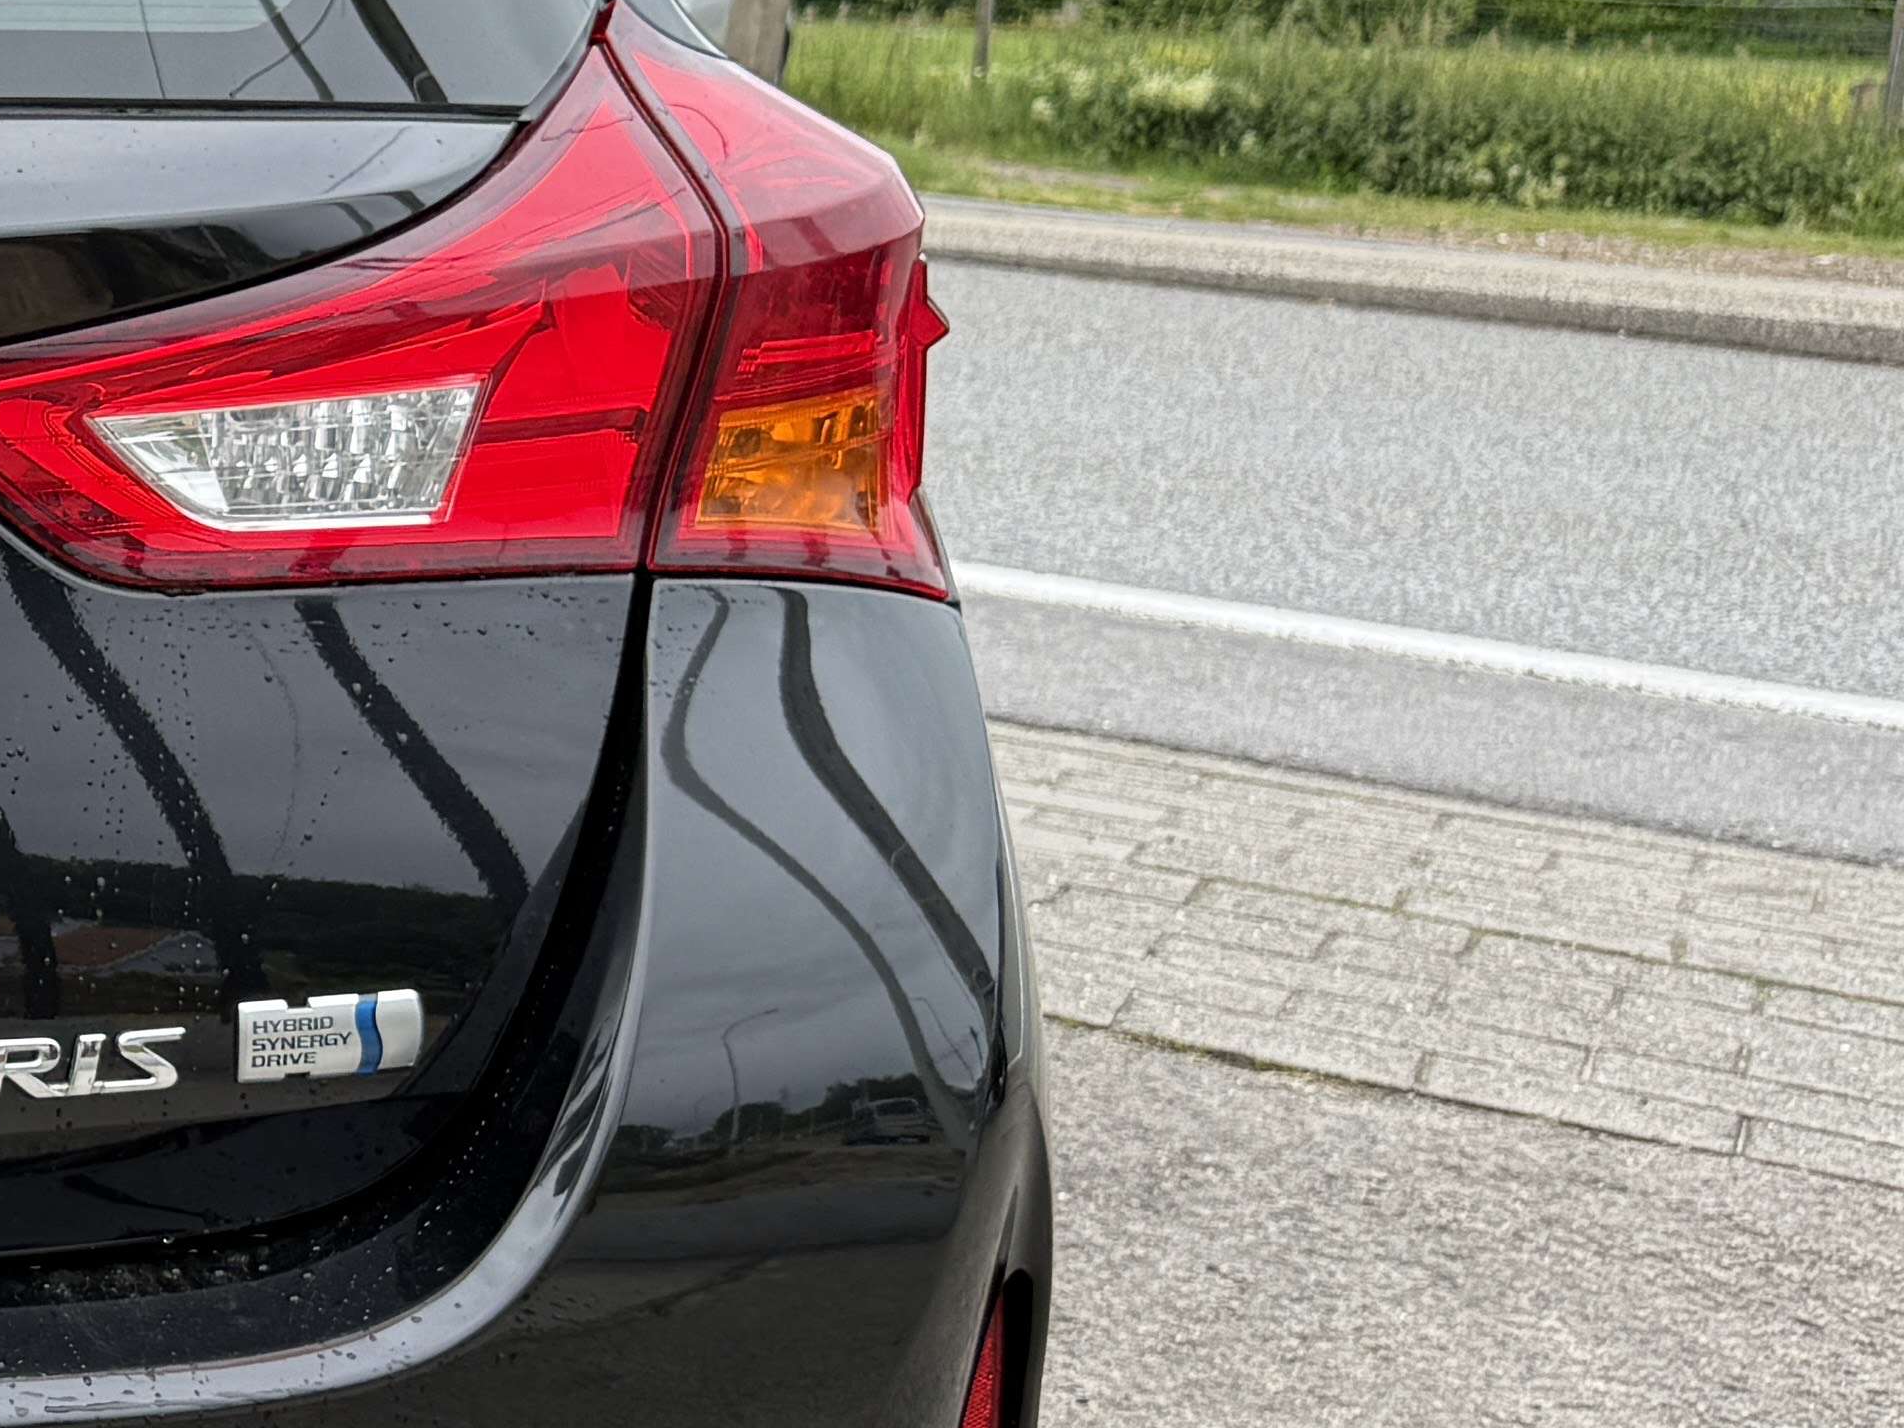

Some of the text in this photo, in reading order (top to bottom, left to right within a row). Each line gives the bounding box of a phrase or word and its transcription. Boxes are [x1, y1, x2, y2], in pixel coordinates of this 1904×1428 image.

[252, 1016, 334, 1035] HYBRID
[252, 1031, 353, 1052] SYNERGY
[251, 1051, 318, 1068] DRIVE
